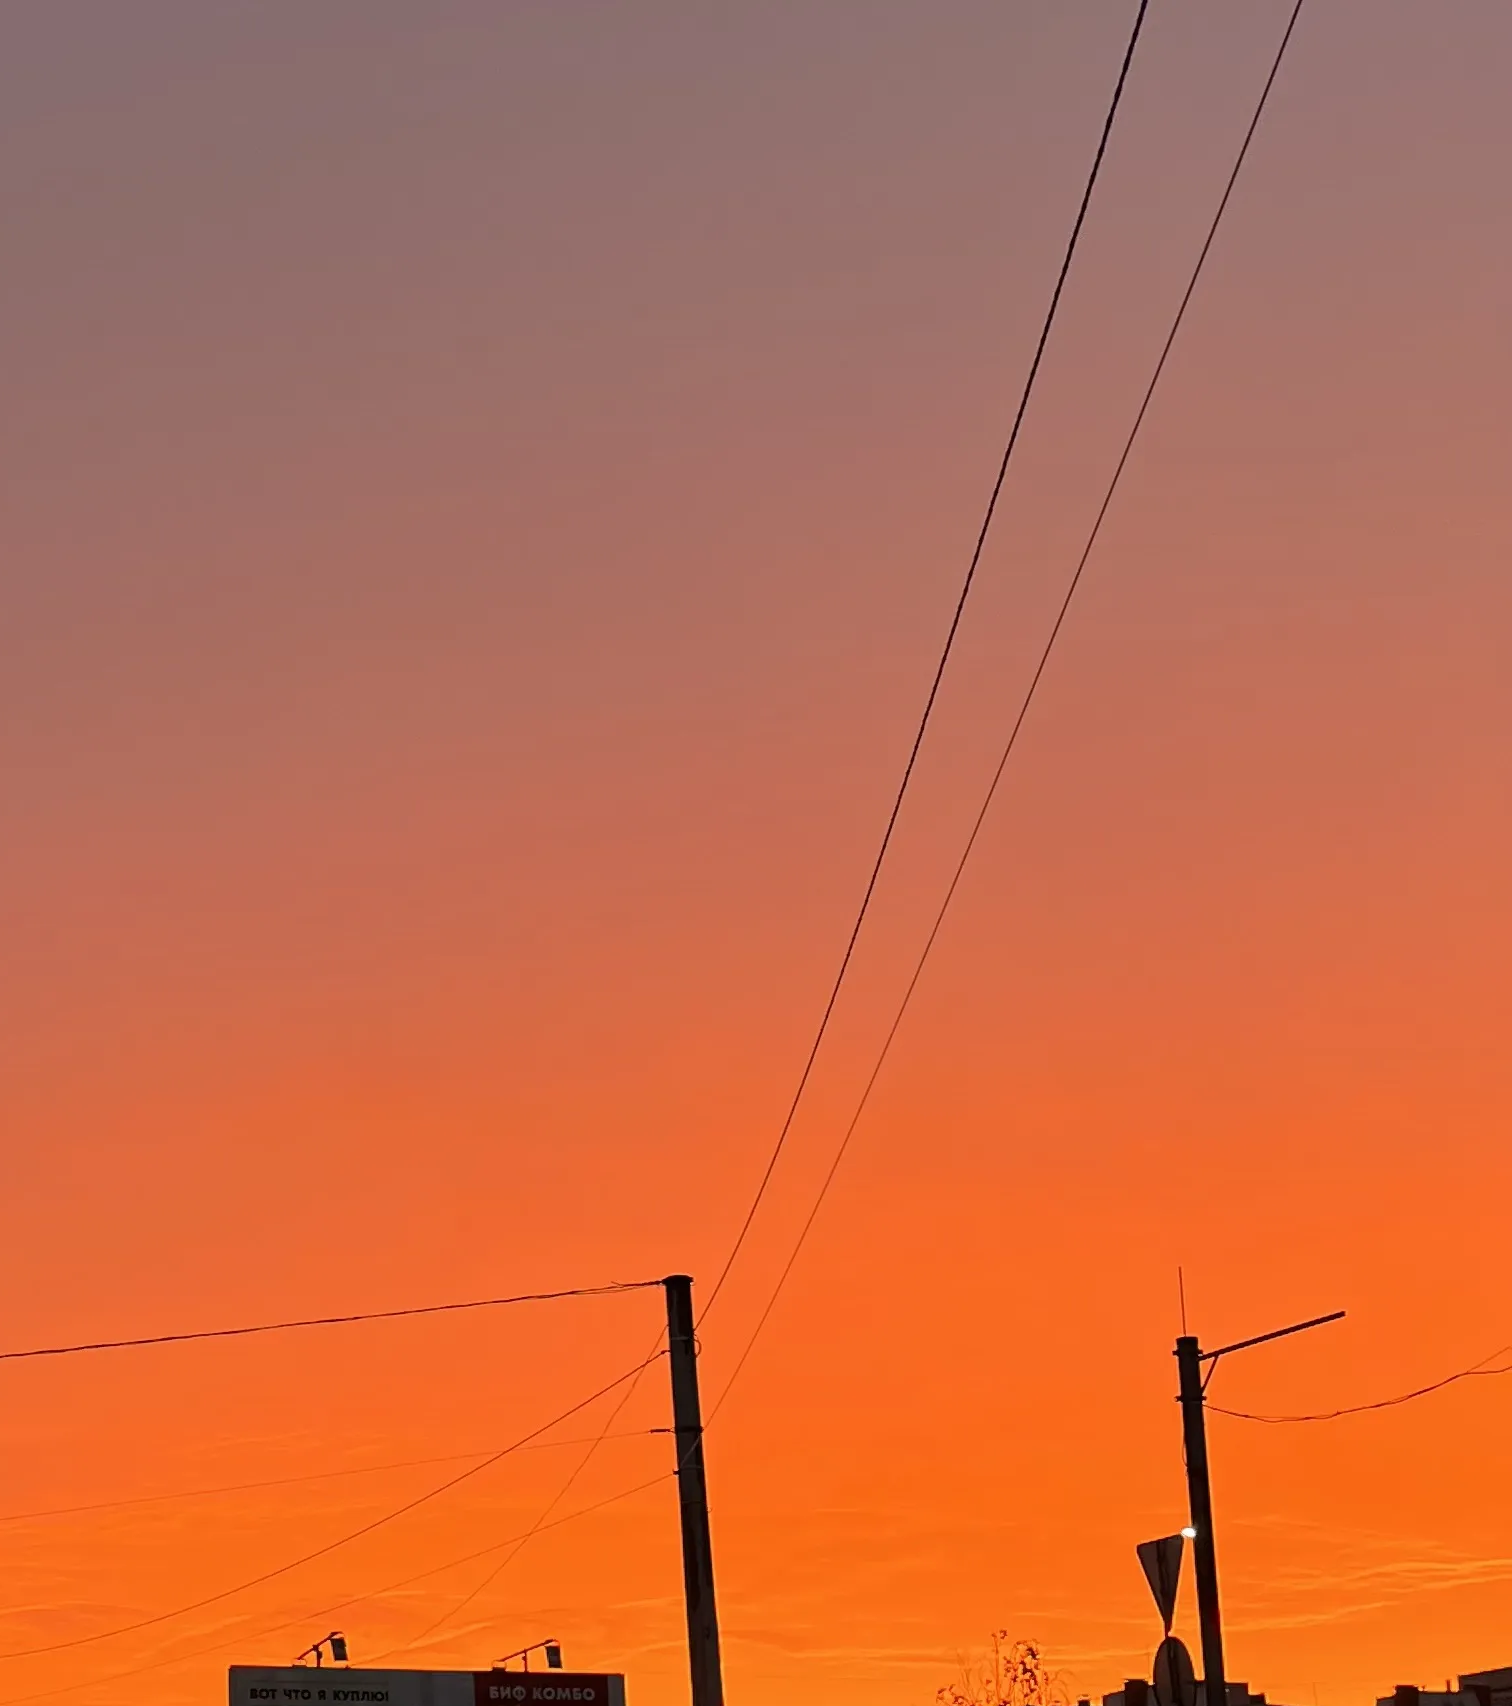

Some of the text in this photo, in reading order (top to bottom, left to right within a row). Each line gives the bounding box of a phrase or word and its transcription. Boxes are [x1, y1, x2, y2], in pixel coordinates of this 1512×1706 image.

[250, 1688, 389, 1702] ВОТ ЧТО Я КУПЛЮ!
[489, 1685, 596, 1702] БИФ КОМБО
